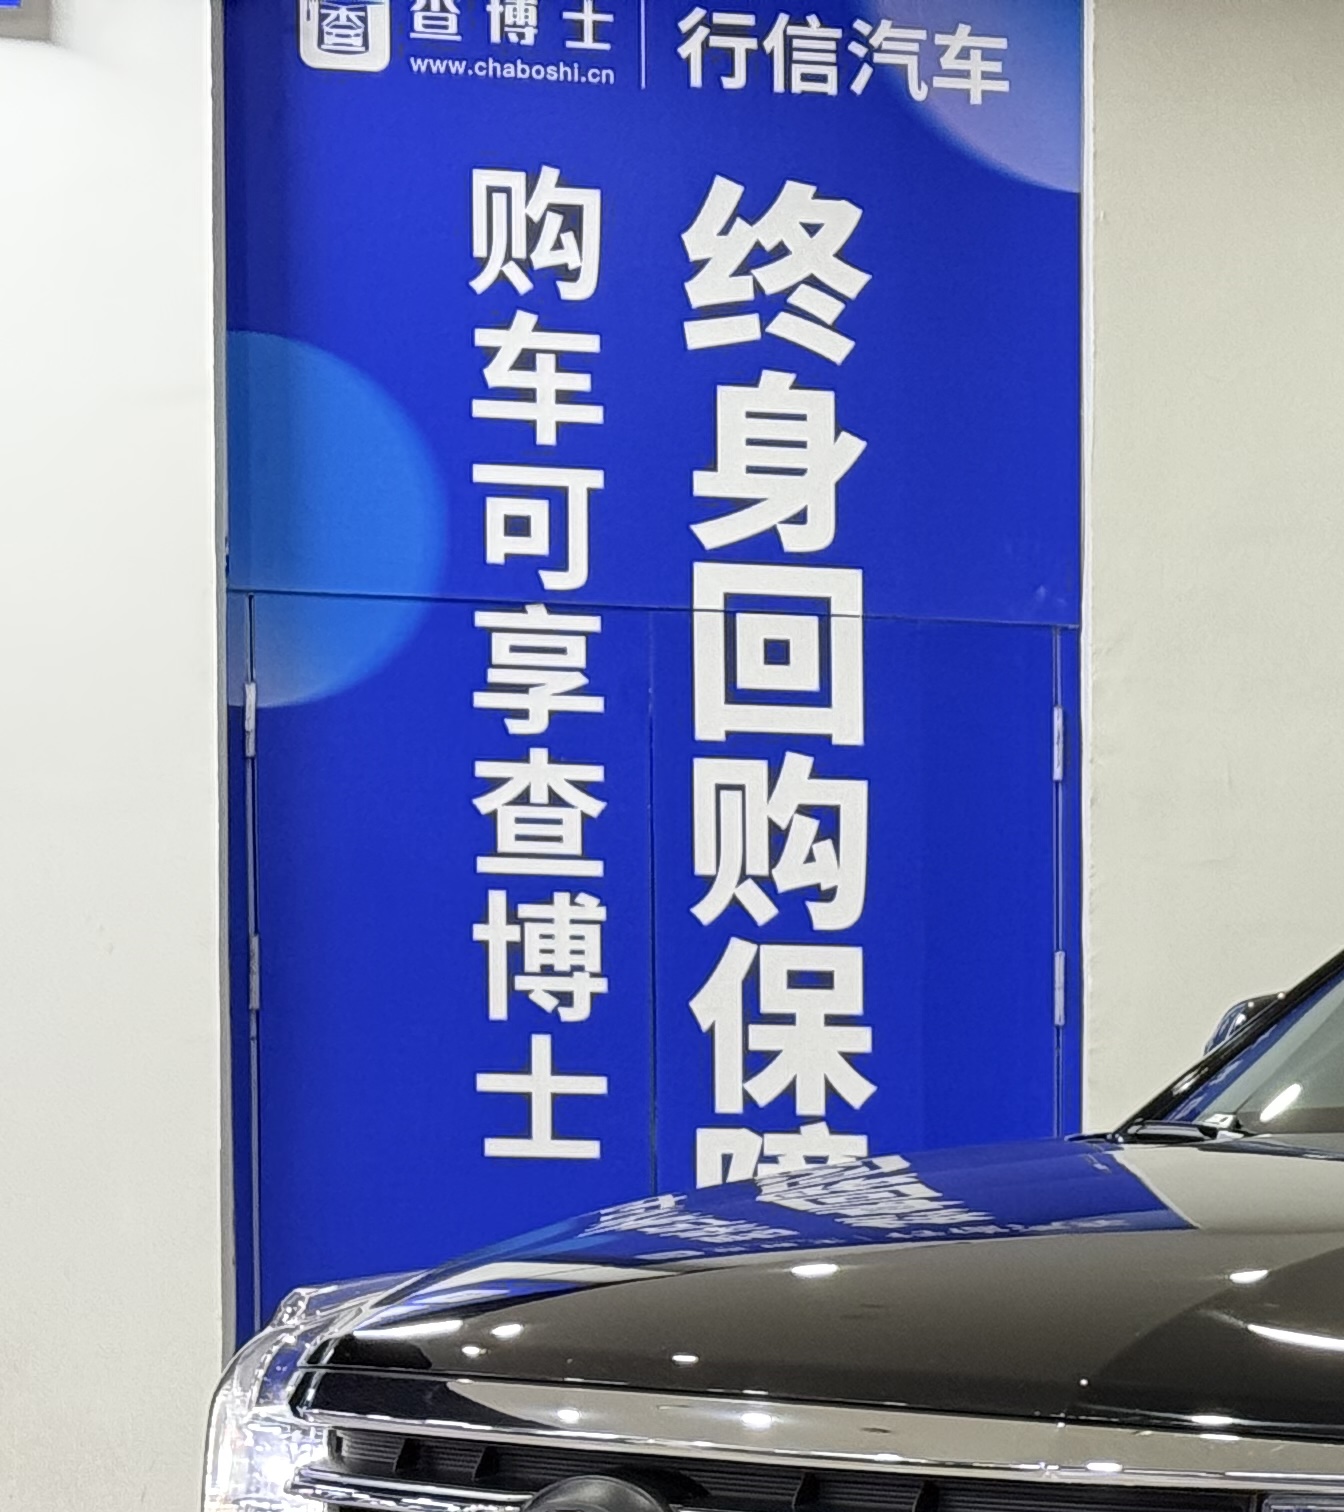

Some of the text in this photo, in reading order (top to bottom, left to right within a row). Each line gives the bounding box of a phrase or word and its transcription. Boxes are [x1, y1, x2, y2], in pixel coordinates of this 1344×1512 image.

[409, 0, 615, 50] 查博士
[676, 6, 1011, 105] 行信汽车
[409, 56, 616, 85] www.chaboshi.cn
[468, 164, 609, 1159] 购车可享查博士
